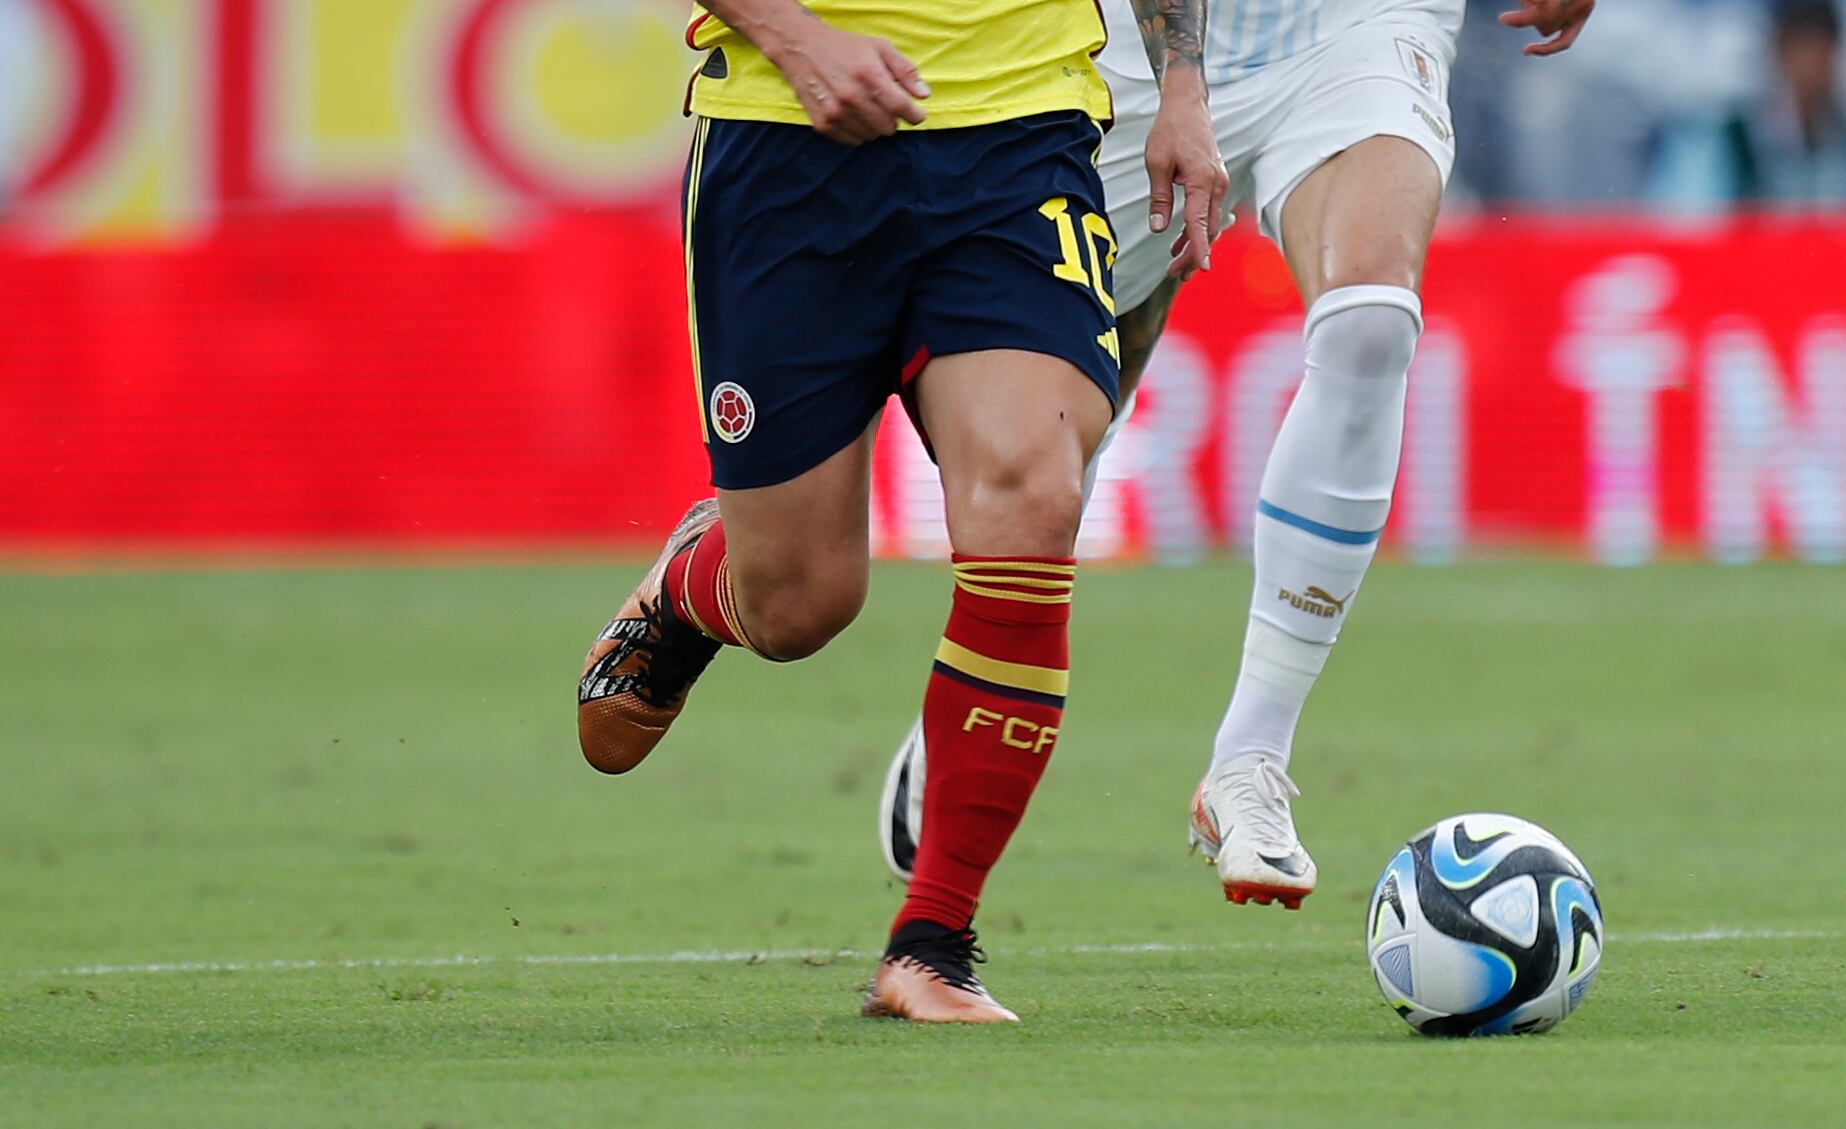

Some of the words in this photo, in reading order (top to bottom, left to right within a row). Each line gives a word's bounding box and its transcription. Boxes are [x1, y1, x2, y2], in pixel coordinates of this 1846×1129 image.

[1038, 197, 1119, 317] 10
[1279, 588, 1337, 618] PUMA
[963, 706, 1060, 754] FCF
